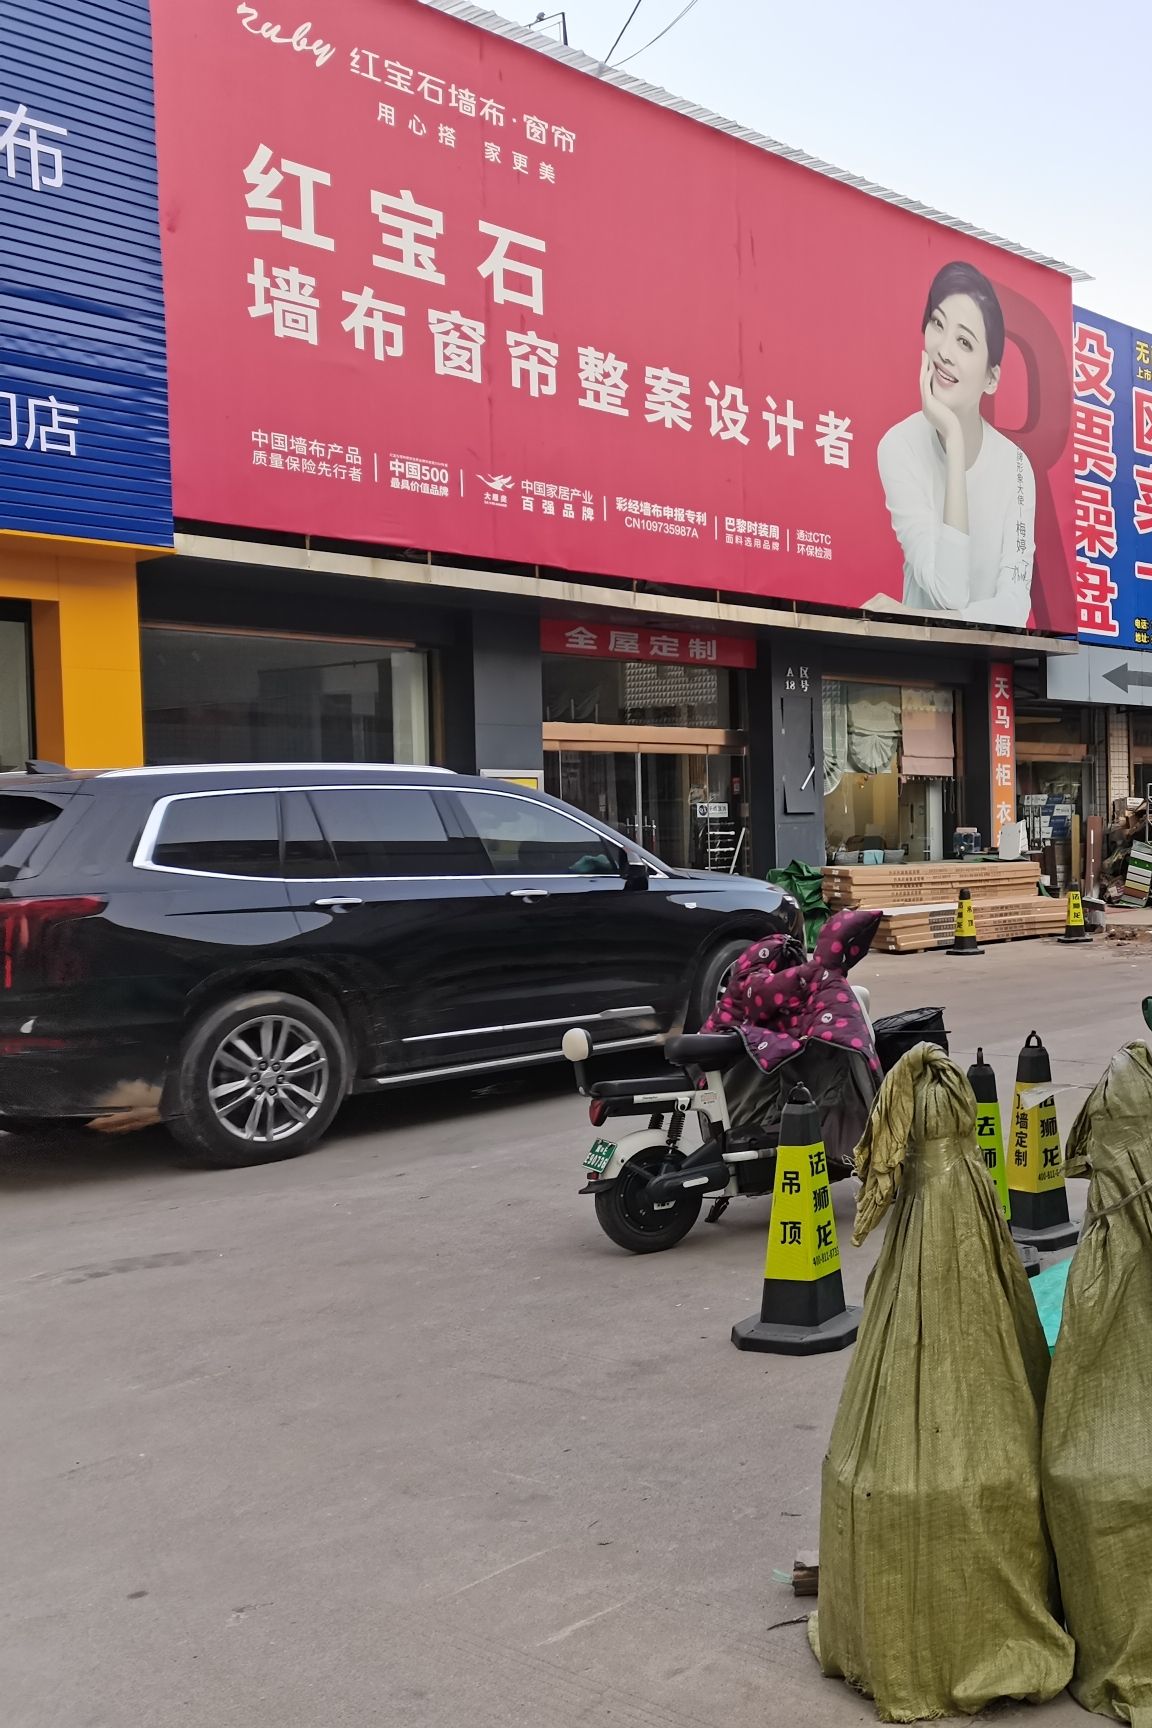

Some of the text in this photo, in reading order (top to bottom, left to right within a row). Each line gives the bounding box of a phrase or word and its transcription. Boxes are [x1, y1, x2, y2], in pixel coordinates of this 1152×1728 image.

[0, 103, 68, 192] 布
[242, 143, 547, 316] 红宝石
[246, 257, 854, 469] 墙布窗帘整案设计者
[251, 428, 362, 465] 中国墙布产品
[251, 449, 363, 483] 质量保险先行者
[389, 459, 449, 484] 中国500
[390, 477, 449, 497] 最具价值品牌
[521, 479, 594, 505] 中国家居产业
[522, 496, 595, 522] 百强品牌
[615, 496, 707, 526] 彩经墙布申报专利
[624, 516, 699, 539] CN109735987A
[724, 516, 780, 540] 巴黎时装周
[564, 626, 718, 661] 全屋定制
[779, 1170, 802, 1246] 吊顶
[808, 1151, 834, 1251] 法狮龙
